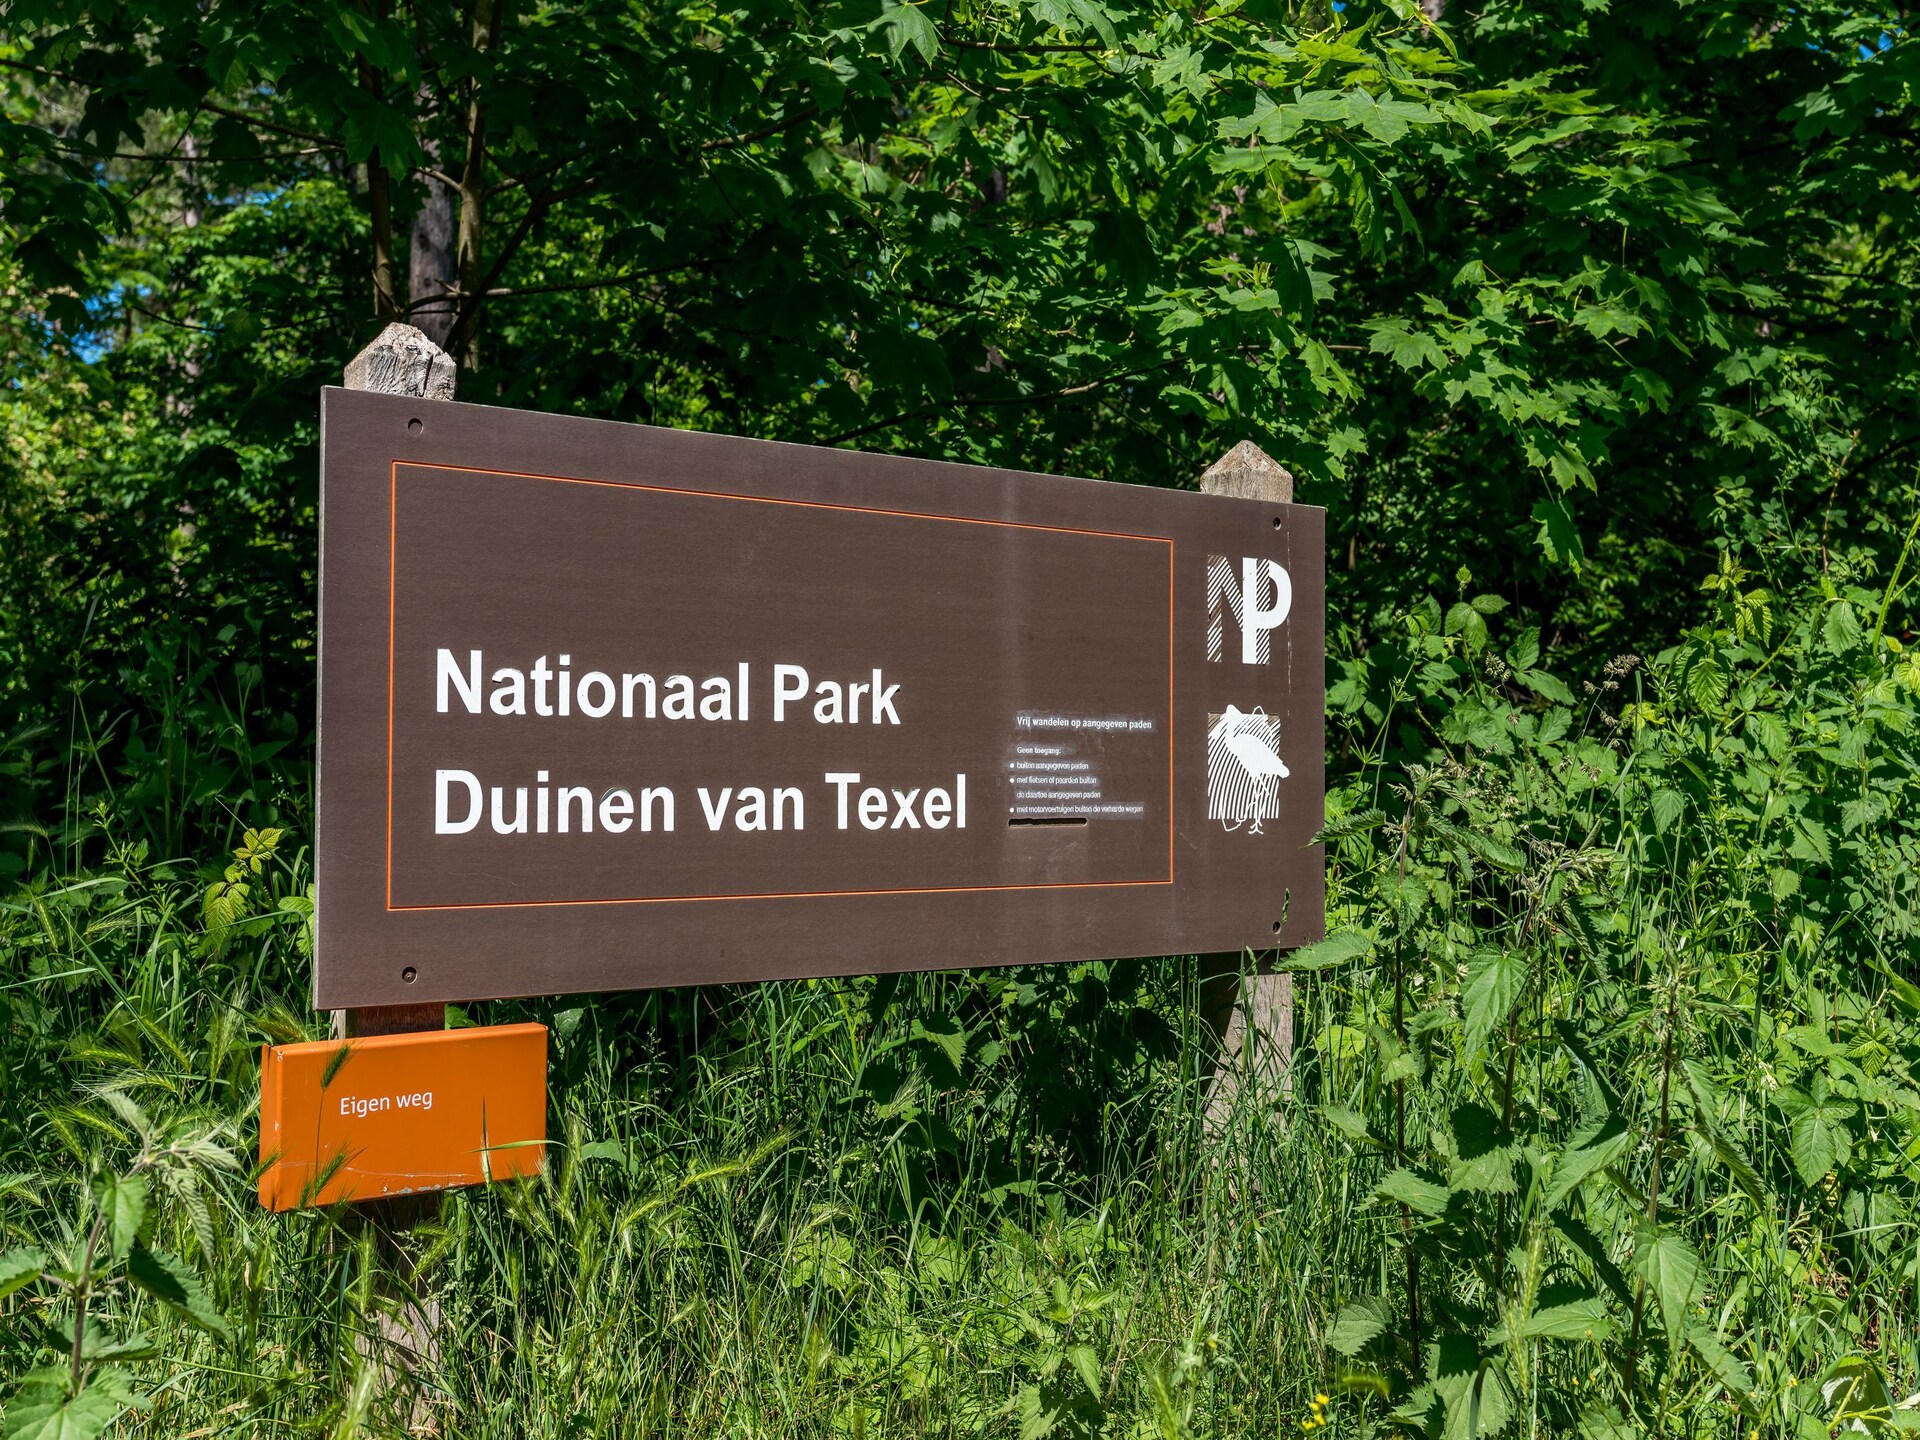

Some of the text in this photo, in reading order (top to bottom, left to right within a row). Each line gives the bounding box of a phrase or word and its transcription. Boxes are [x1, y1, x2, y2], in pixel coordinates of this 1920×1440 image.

[436, 648, 902, 725] Nationaal Park
[1017, 716, 1152, 730] Vrij wandelen op aangegeven paden
[1016, 746, 1062, 756] Geen toegang:
[1016, 761, 1089, 771] buiten aangegeven paden
[1016, 776, 1028, 784] met
[1028, 776, 1048, 784] fietsen
[1055, 776, 1079, 785] paarden
[1079, 776, 1097, 784] buiten
[1048, 791, 1083, 800] aangegeven
[1083, 791, 1101, 800] paden
[435, 769, 967, 834] Duinen van Texel
[1016, 805, 1028, 813] met
[1075, 805, 1093, 813] buiten
[1093, 805, 1100, 813] de
[1125, 806, 1144, 814] wegen
[339, 1091, 433, 1118] Eigen weg
